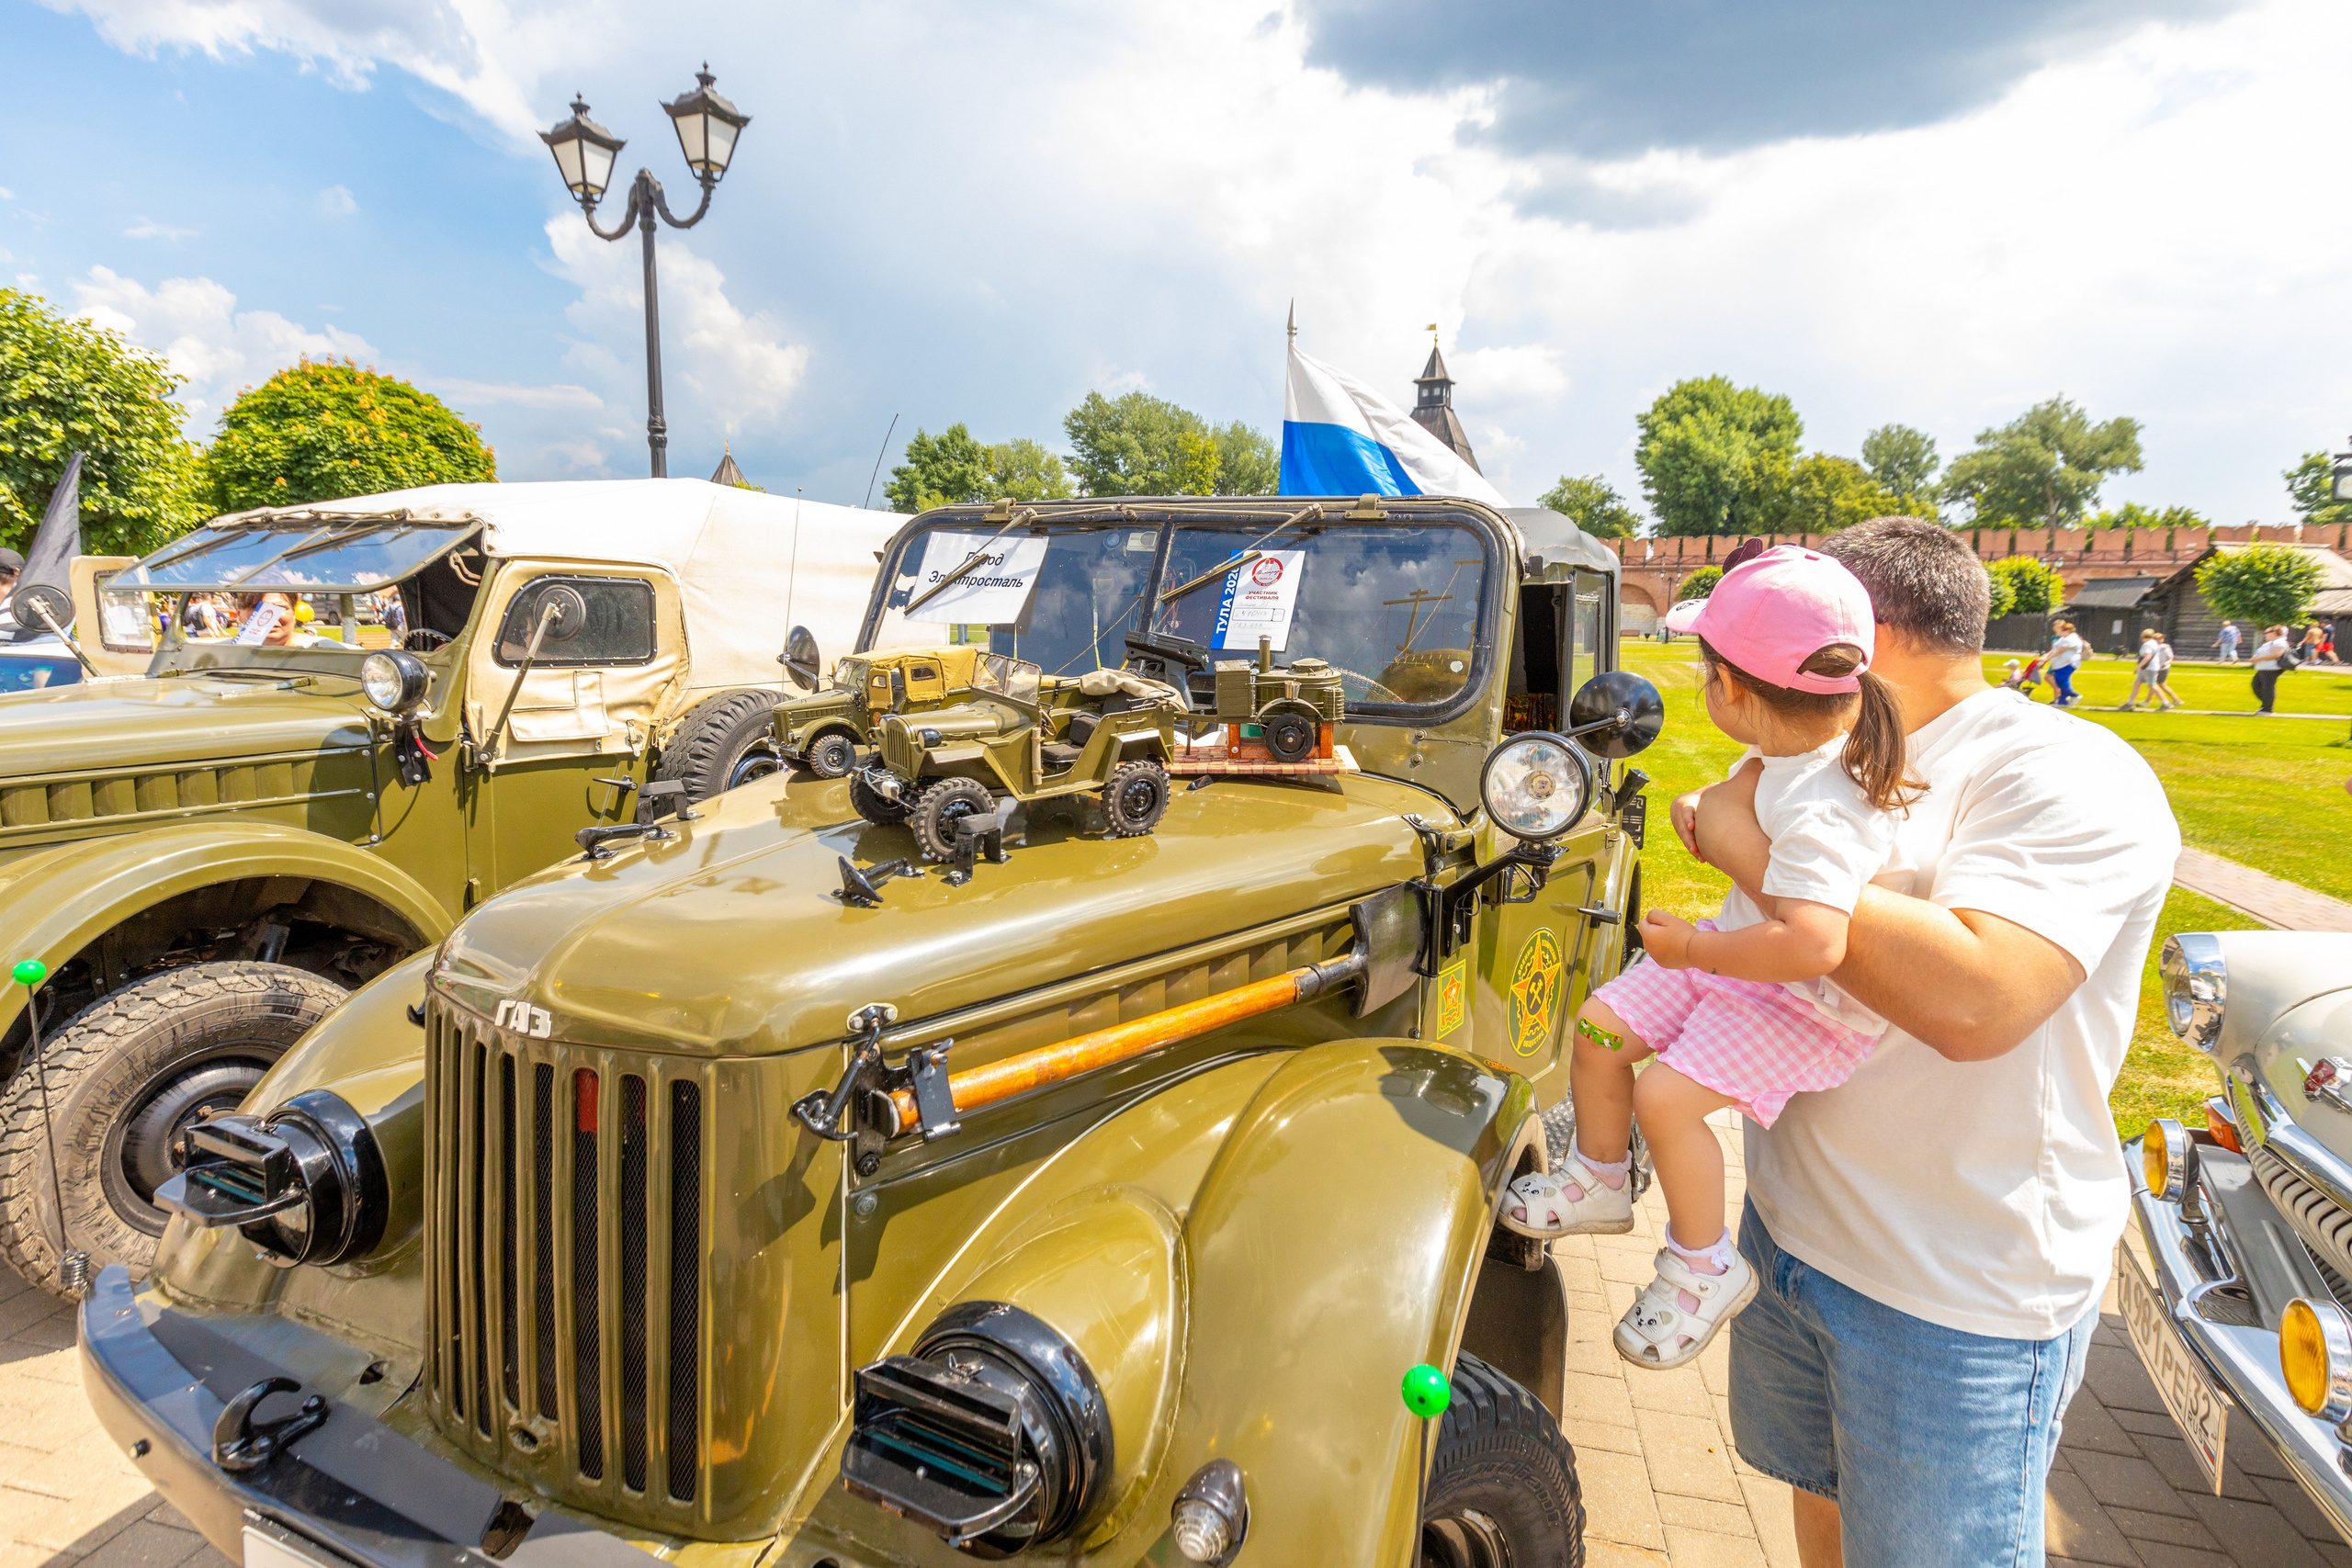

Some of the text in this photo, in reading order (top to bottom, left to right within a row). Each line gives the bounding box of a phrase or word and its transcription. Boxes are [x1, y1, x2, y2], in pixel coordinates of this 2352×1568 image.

[928, 570, 1023, 589] Элтросталь
[1216, 598, 1233, 634] ТУЛА
[494, 999, 552, 1039] ГАЗ
[2189, 1373, 2211, 1438] 32
[2187, 1412, 2205, 1445] RUS
